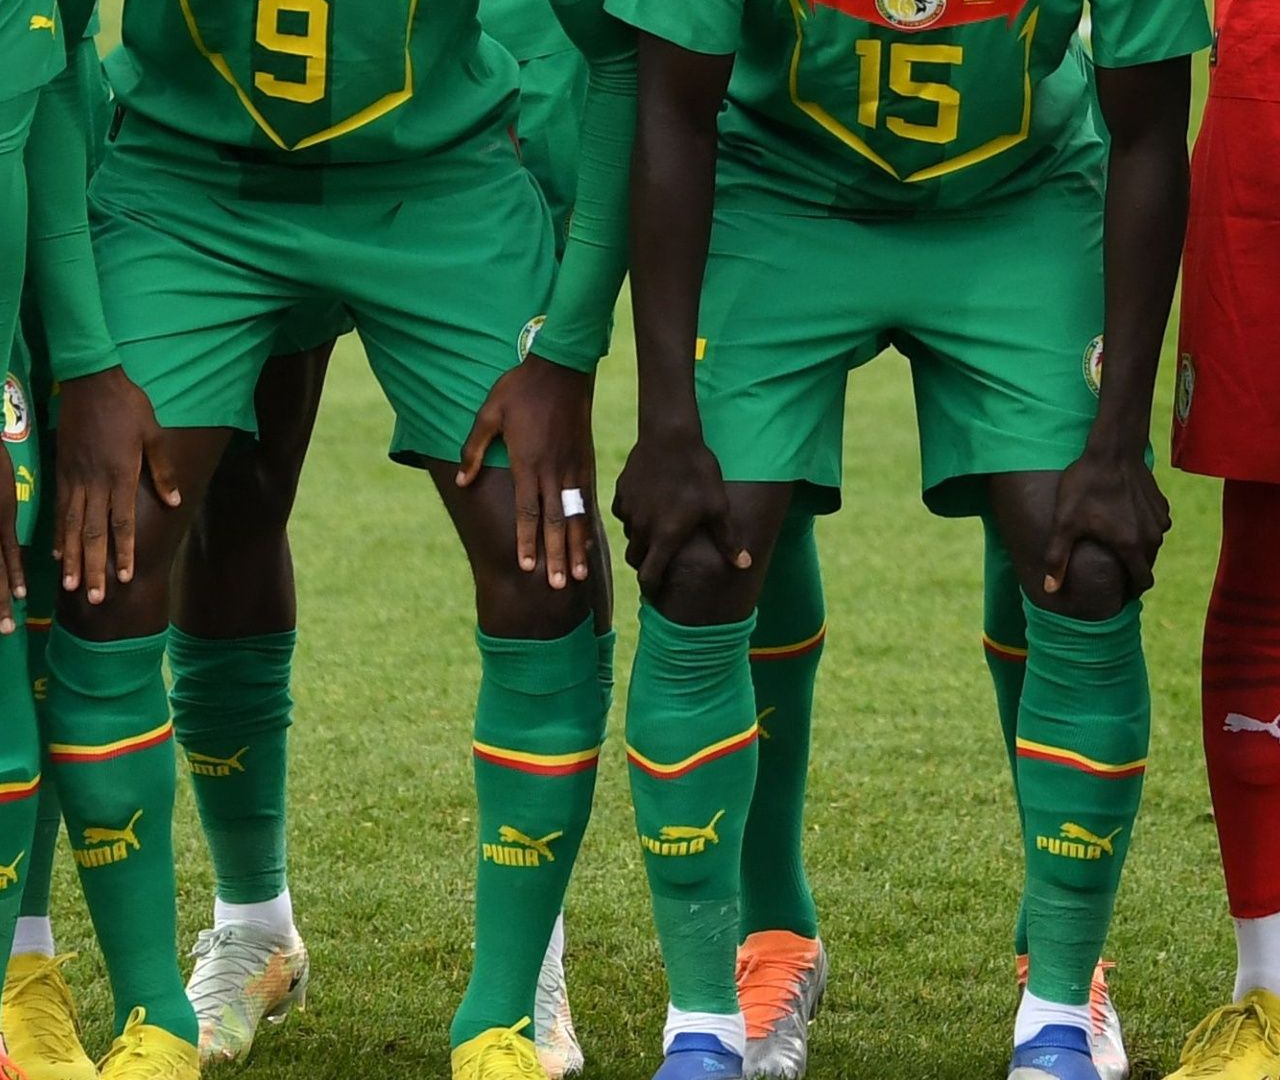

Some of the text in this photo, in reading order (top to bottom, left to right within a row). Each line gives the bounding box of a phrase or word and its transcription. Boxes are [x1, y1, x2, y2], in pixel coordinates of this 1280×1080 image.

[855, 40, 963, 144] 15
[483, 843, 539, 866] PUMA
[640, 834, 705, 856] PUMA
[1036, 836, 1101, 859] PUMA
